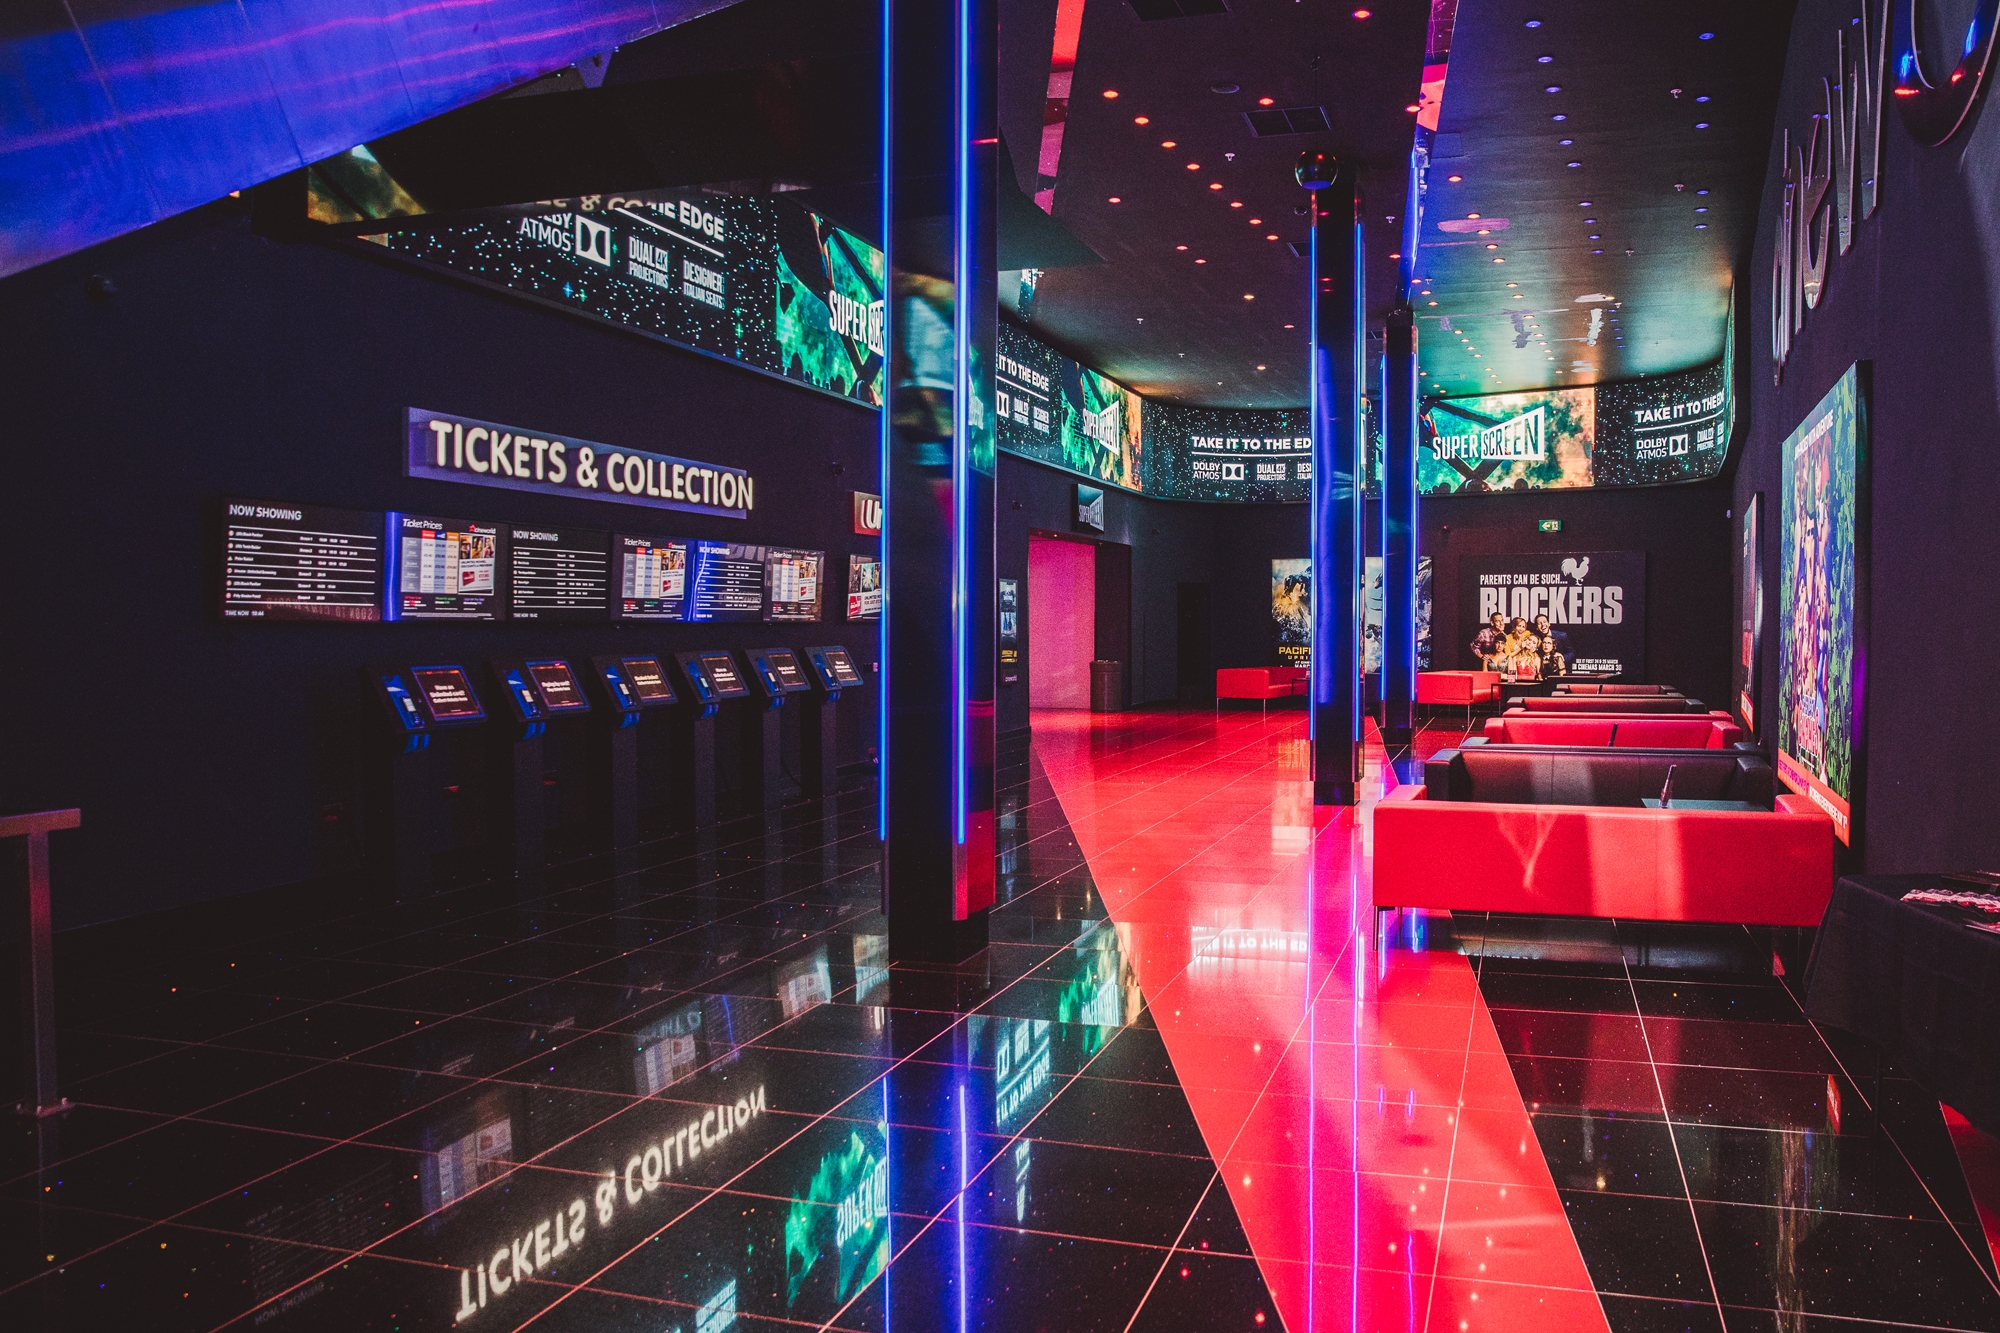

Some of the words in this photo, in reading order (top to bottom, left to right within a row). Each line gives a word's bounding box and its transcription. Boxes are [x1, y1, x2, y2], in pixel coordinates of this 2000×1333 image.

[519, 217, 572, 252] ATMOS
[679, 200, 725, 242] EDGE
[628, 236, 655, 268] DUAL
[628, 260, 669, 289] PROJECTORS
[683, 259, 723, 292] DESIGNER
[683, 281, 705, 303] ITALIAN
[706, 289, 723, 310] SEATS
[829, 289, 868, 344] SUPER
[1007, 358, 1017, 377] TO
[1018, 363, 1032, 384] THE
[1032, 370, 1050, 392] EDGE
[1634, 406, 1671, 423] TAKE
[1674, 404, 1684, 419] IT
[1686, 401, 1701, 416] TO
[1702, 395, 1716, 412] THE
[1192, 436, 1224, 449] TAKE
[1226, 437, 1239, 450] IT
[1242, 438, 1260, 450] TO
[1264, 438, 1291, 450] THE
[1433, 434, 1478, 460] SUPER
[1482, 411, 1541, 457] SCREEN
[1636, 437, 1668, 450] DOLBY
[429, 420, 568, 484] TICKETS
[576, 446, 599, 489] &
[606, 452, 753, 511] COLLECTION
[1193, 462, 1220, 472] DOLBY
[1636, 448, 1667, 460] ATMOS
[1193, 471, 1220, 480] ATMOS
[1257, 464, 1276, 474] DUAL
[229, 504, 255, 517] NOW
[256, 507, 302, 521] SHOWING
[403, 519, 423, 529] Ticket
[423, 520, 443, 530] Prices
[513, 530, 529, 539] NOW
[530, 532, 559, 542] SHOWING
[1480, 574, 1512, 585] PARENTS
[1513, 574, 1528, 585] CAN
[1530, 574, 1540, 585] BE
[1541, 574, 1568, 585] SUCH...
[1480, 586, 1624, 625] BLOCKERS
